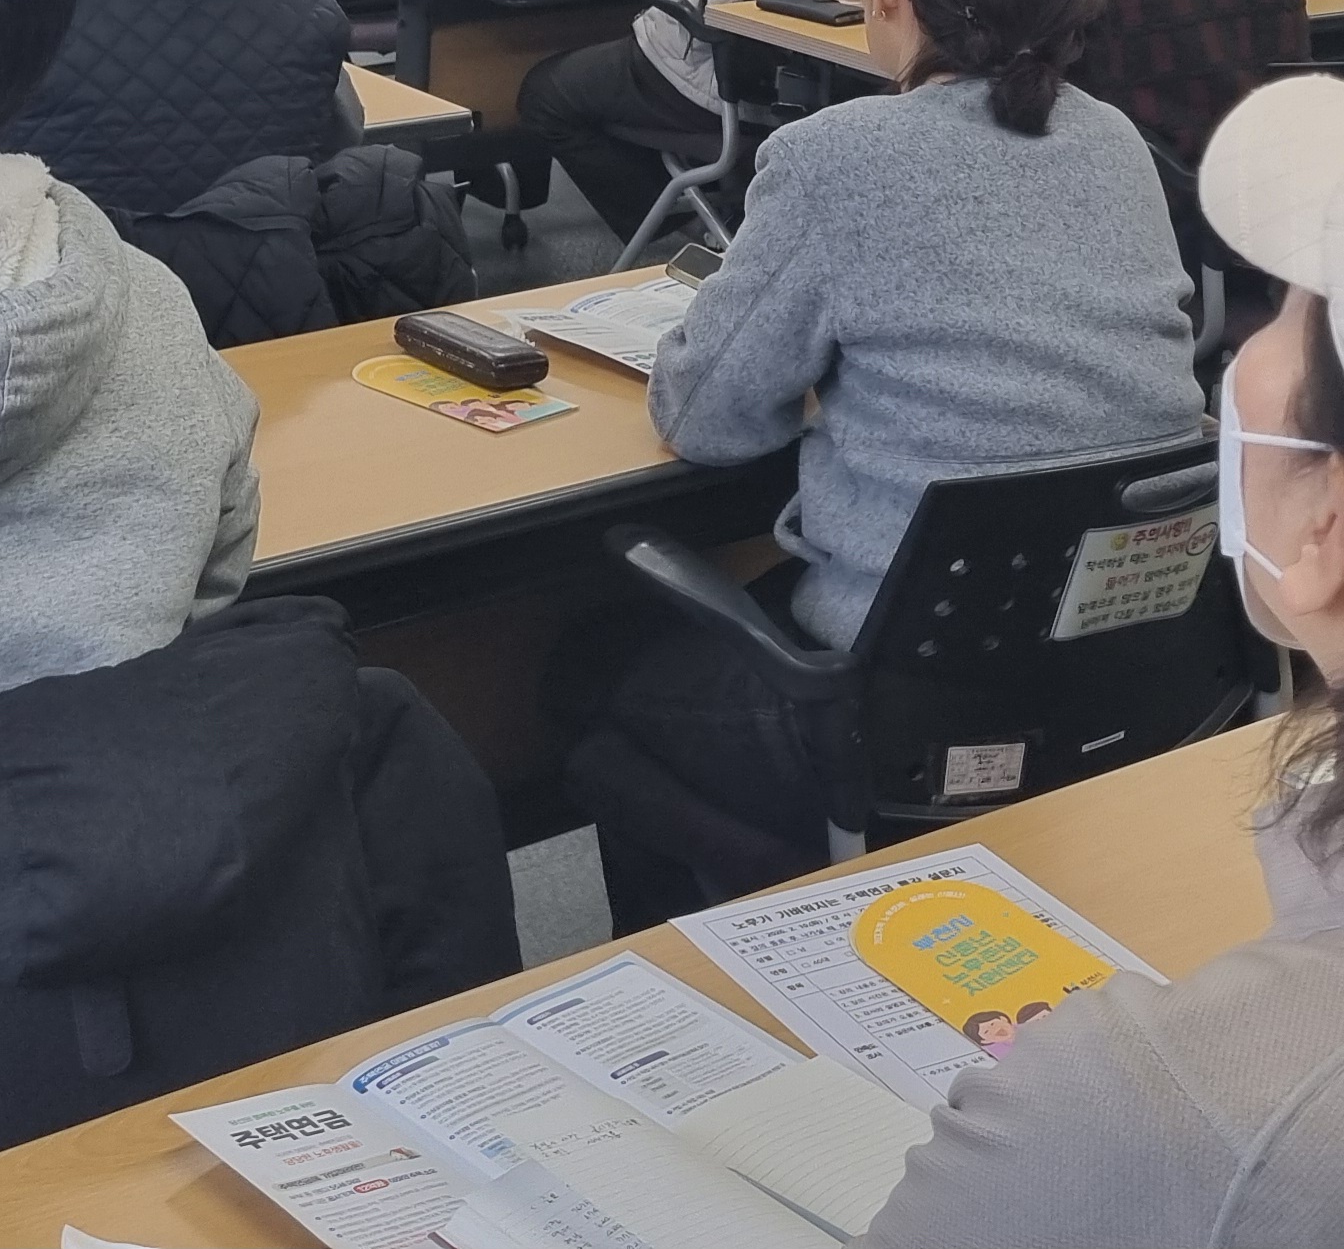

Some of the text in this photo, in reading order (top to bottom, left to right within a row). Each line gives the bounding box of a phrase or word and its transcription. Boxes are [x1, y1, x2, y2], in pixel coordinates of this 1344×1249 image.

[778, 897, 841, 920] 가벼워지는
[842, 882, 894, 903] 주택연금
[927, 866, 967, 881] 설문지
[912, 914, 976, 951] 부천시
[935, 929, 997, 967] 신중년
[942, 936, 1023, 985] 노후준비
[230, 1109, 353, 1150] 주택연금
